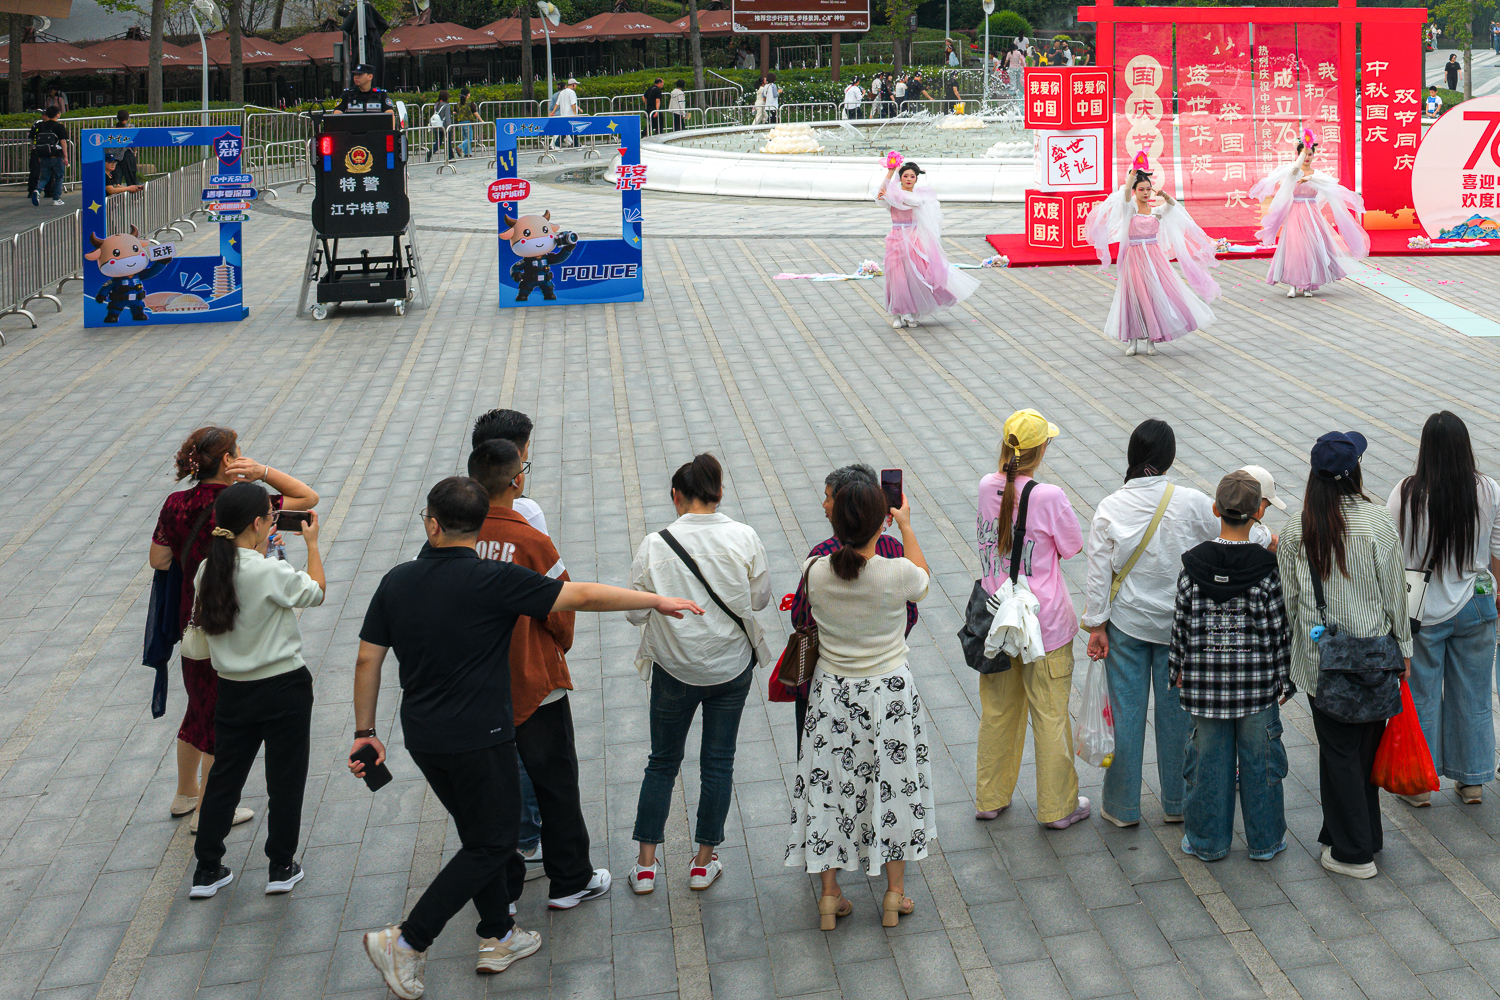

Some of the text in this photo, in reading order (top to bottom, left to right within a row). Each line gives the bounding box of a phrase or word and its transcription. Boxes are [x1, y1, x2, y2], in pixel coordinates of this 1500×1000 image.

[1030, 81, 1060, 95] 我爱你
[1073, 80, 1106, 95] 我爱你
[1033, 100, 1057, 117] 中国
[1076, 99, 1103, 116] 中国
[1258, 45, 1273, 174] 热烈庆祝中华人民共和国
[1365, 60, 1389, 142] 中秋国庆
[1186, 64, 1215, 174] 盛世华诞
[1393, 89, 1418, 170] 双节同庆
[218, 148, 239, 157] 无诈
[219, 140, 238, 149] 天下
[1219, 103, 1250, 208] 举国同庆
[616, 164, 648, 178] 平安
[340, 176, 380, 192] 特警
[615, 177, 647, 191] 江宁
[331, 201, 390, 216] 江宁特警
[1033, 202, 1059, 220] 欢度
[1033, 224, 1059, 242] 国庆
[152, 245, 173, 258] 反诈
[561, 263, 638, 282] POLICE
